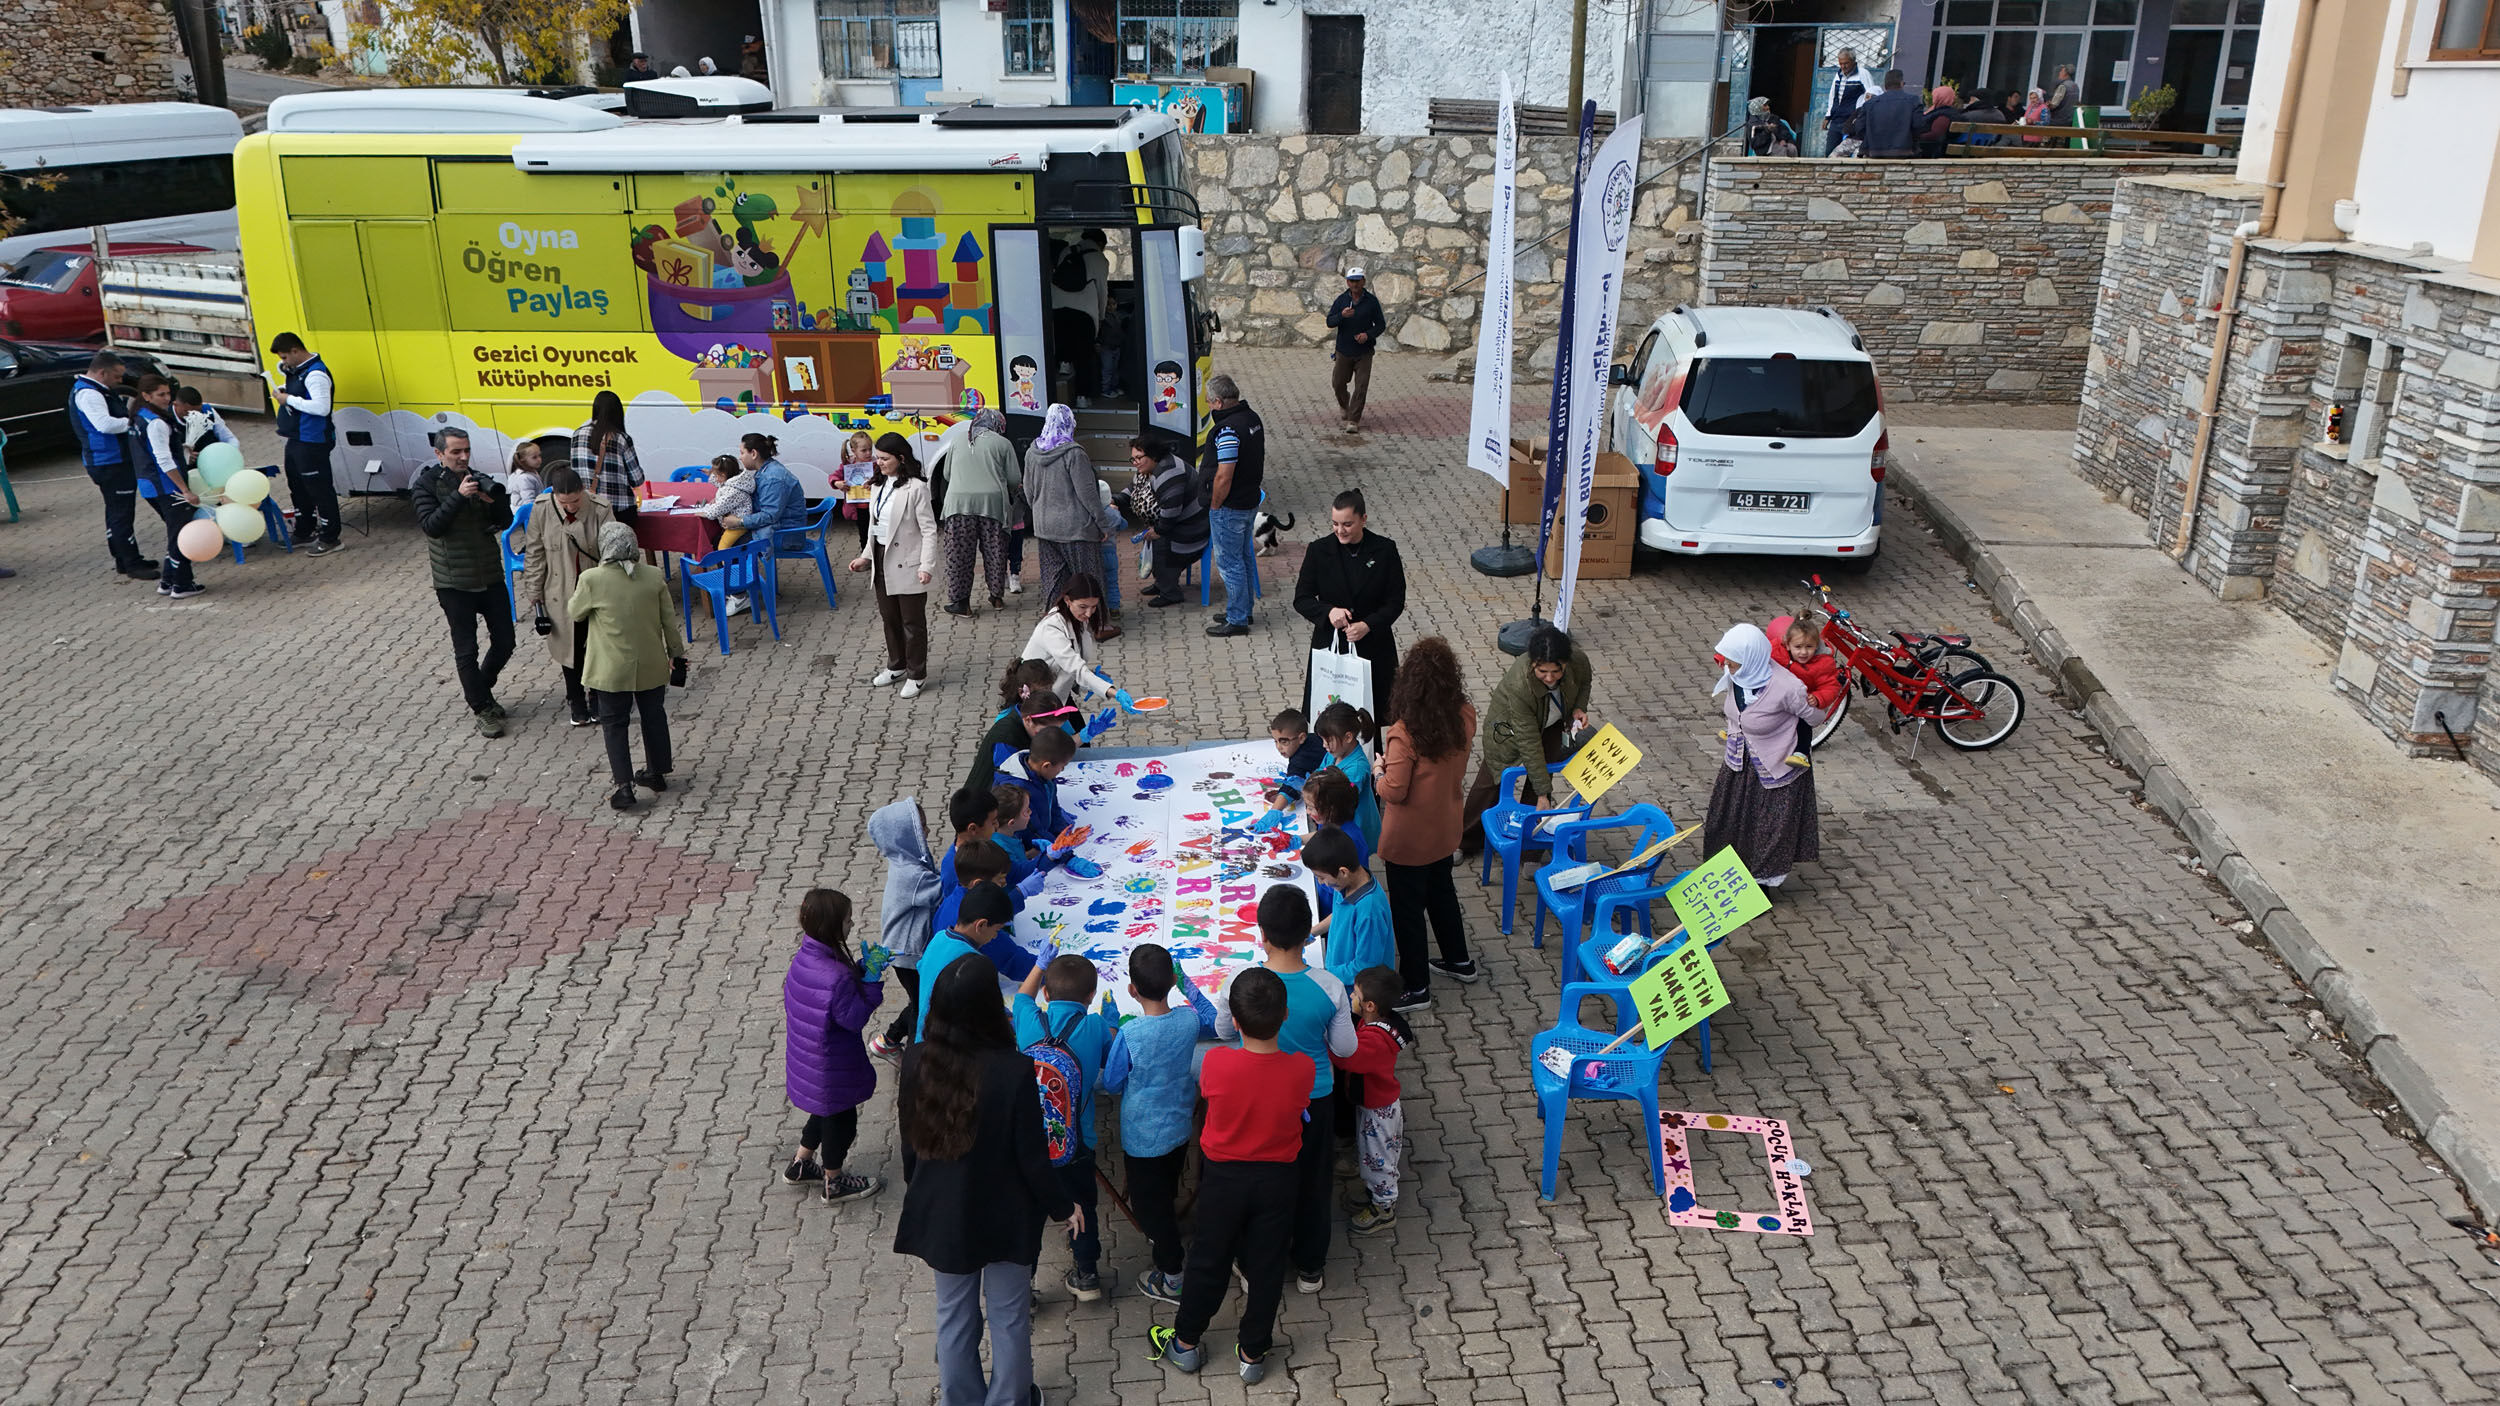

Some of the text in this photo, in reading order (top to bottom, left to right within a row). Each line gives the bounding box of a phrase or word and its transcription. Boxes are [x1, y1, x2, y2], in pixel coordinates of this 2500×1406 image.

[498, 222, 579, 256] Oyna
[462, 240, 561, 284] Öğren
[506, 285, 609, 318] Paylaş
[473, 345, 639, 367] Gezici Oyuncak
[477, 370, 612, 391] Kütüphanesi
[1736, 494, 1806, 509] 48 EE 721
[1585, 749, 1615, 781] HAKKIM
[1601, 737, 1629, 765] OYUN
[1699, 871, 1738, 918] ÇOCUK
[1720, 866, 1748, 897] HER
[1679, 949, 1714, 1008] EĞİTİM
[1762, 1120, 1807, 1233] ÇOCUK HAKLARI
